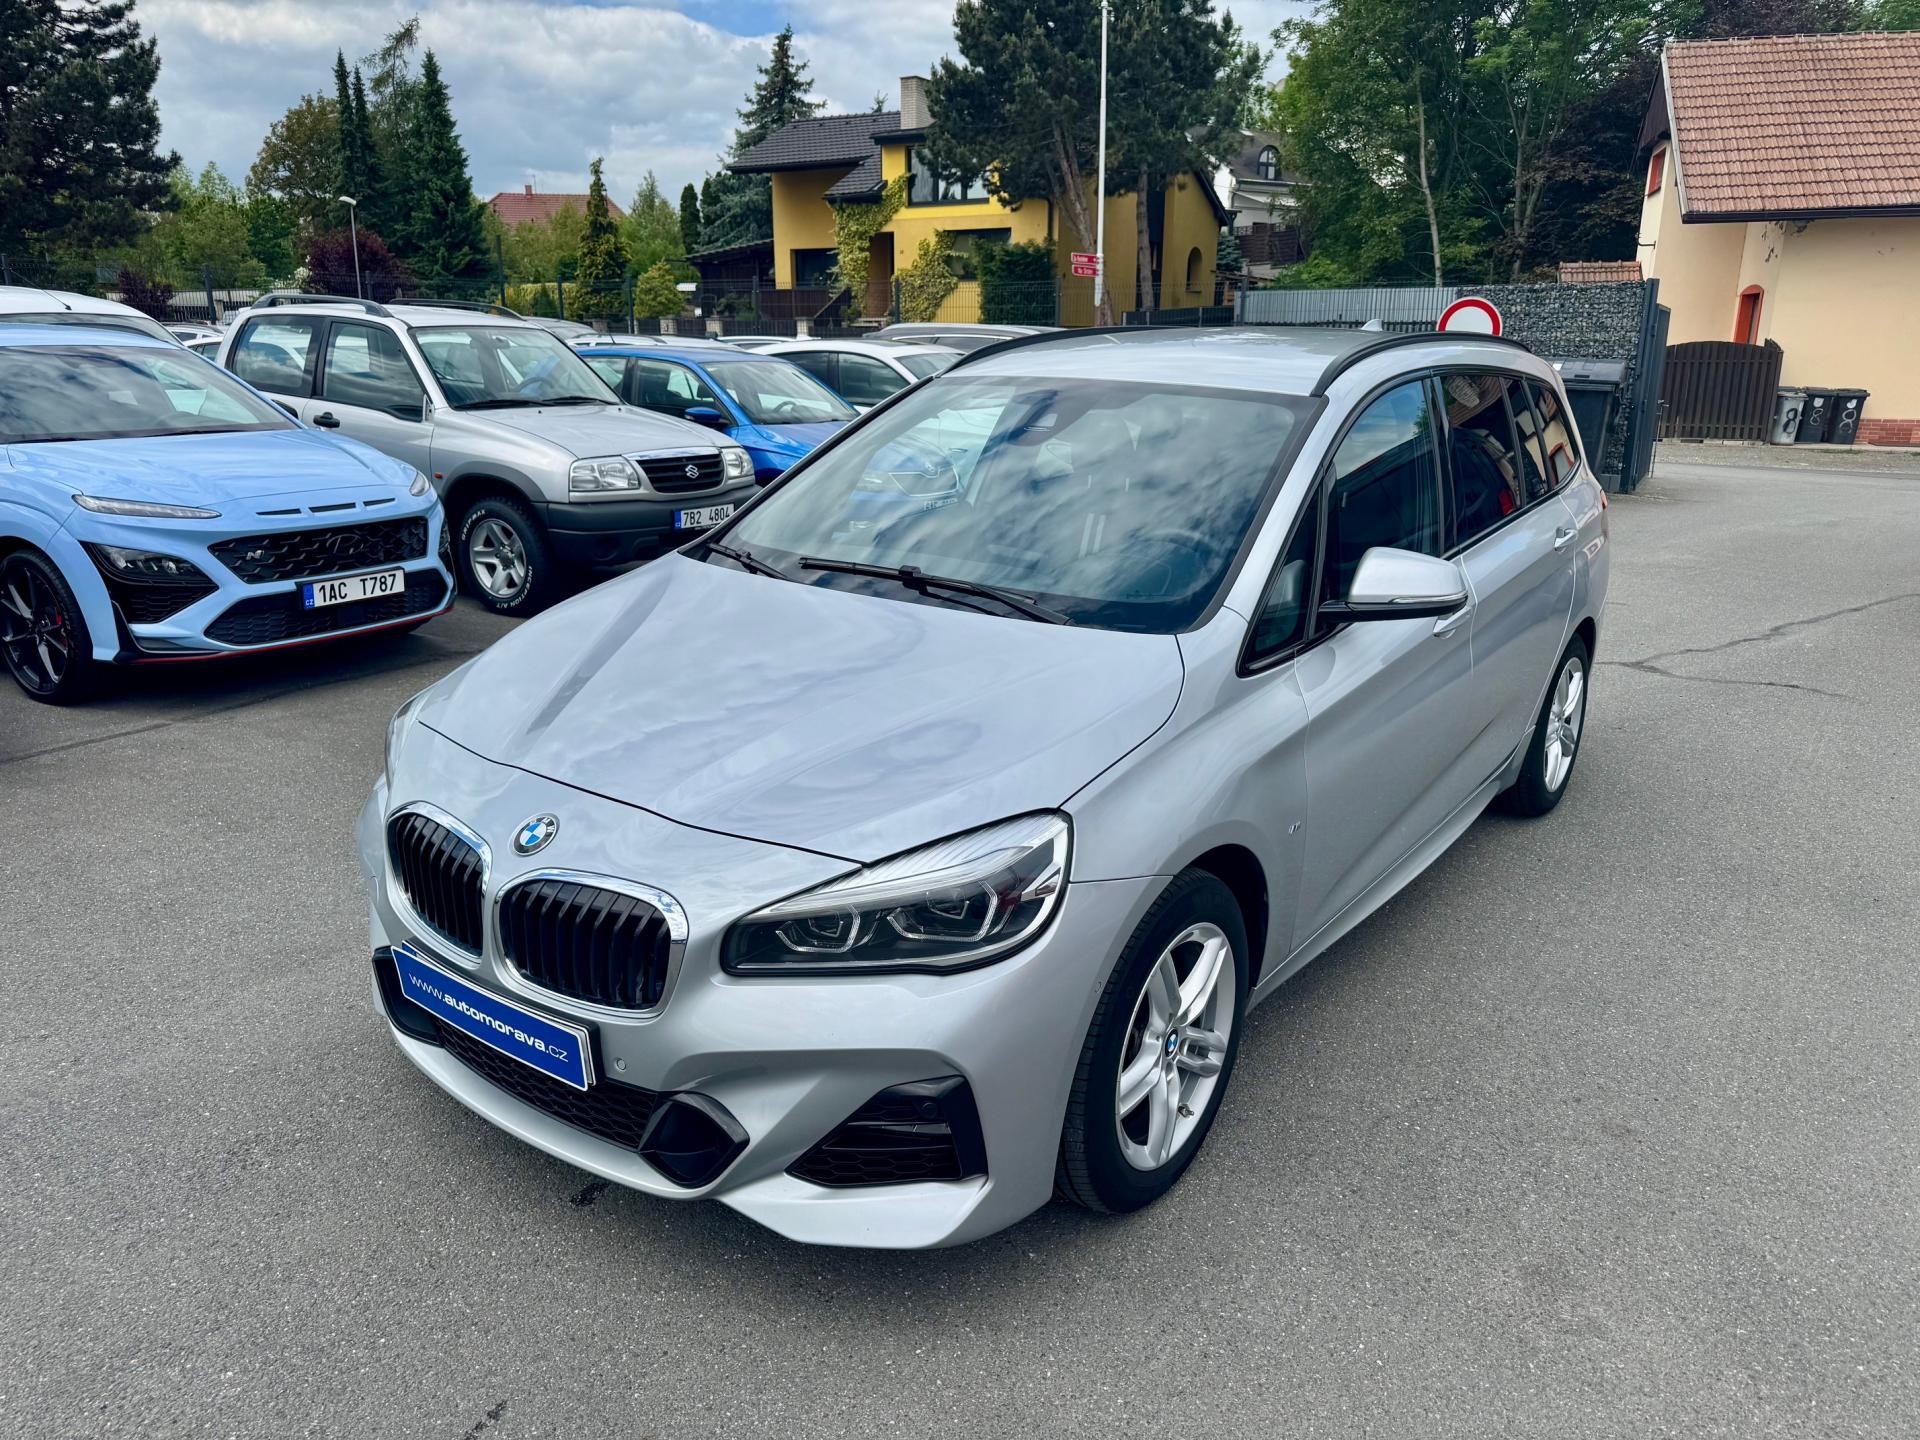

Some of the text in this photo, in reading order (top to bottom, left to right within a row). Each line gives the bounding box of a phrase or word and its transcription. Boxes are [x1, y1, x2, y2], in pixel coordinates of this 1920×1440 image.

[1783, 408, 1798, 434] 8
[1810, 408, 1824, 425] 8
[684, 511, 702, 526] 7B2
[709, 507, 730, 522] 4804
[318, 574, 397, 603] 1AC T787
[409, 973, 569, 1063] www.automorava.cz
